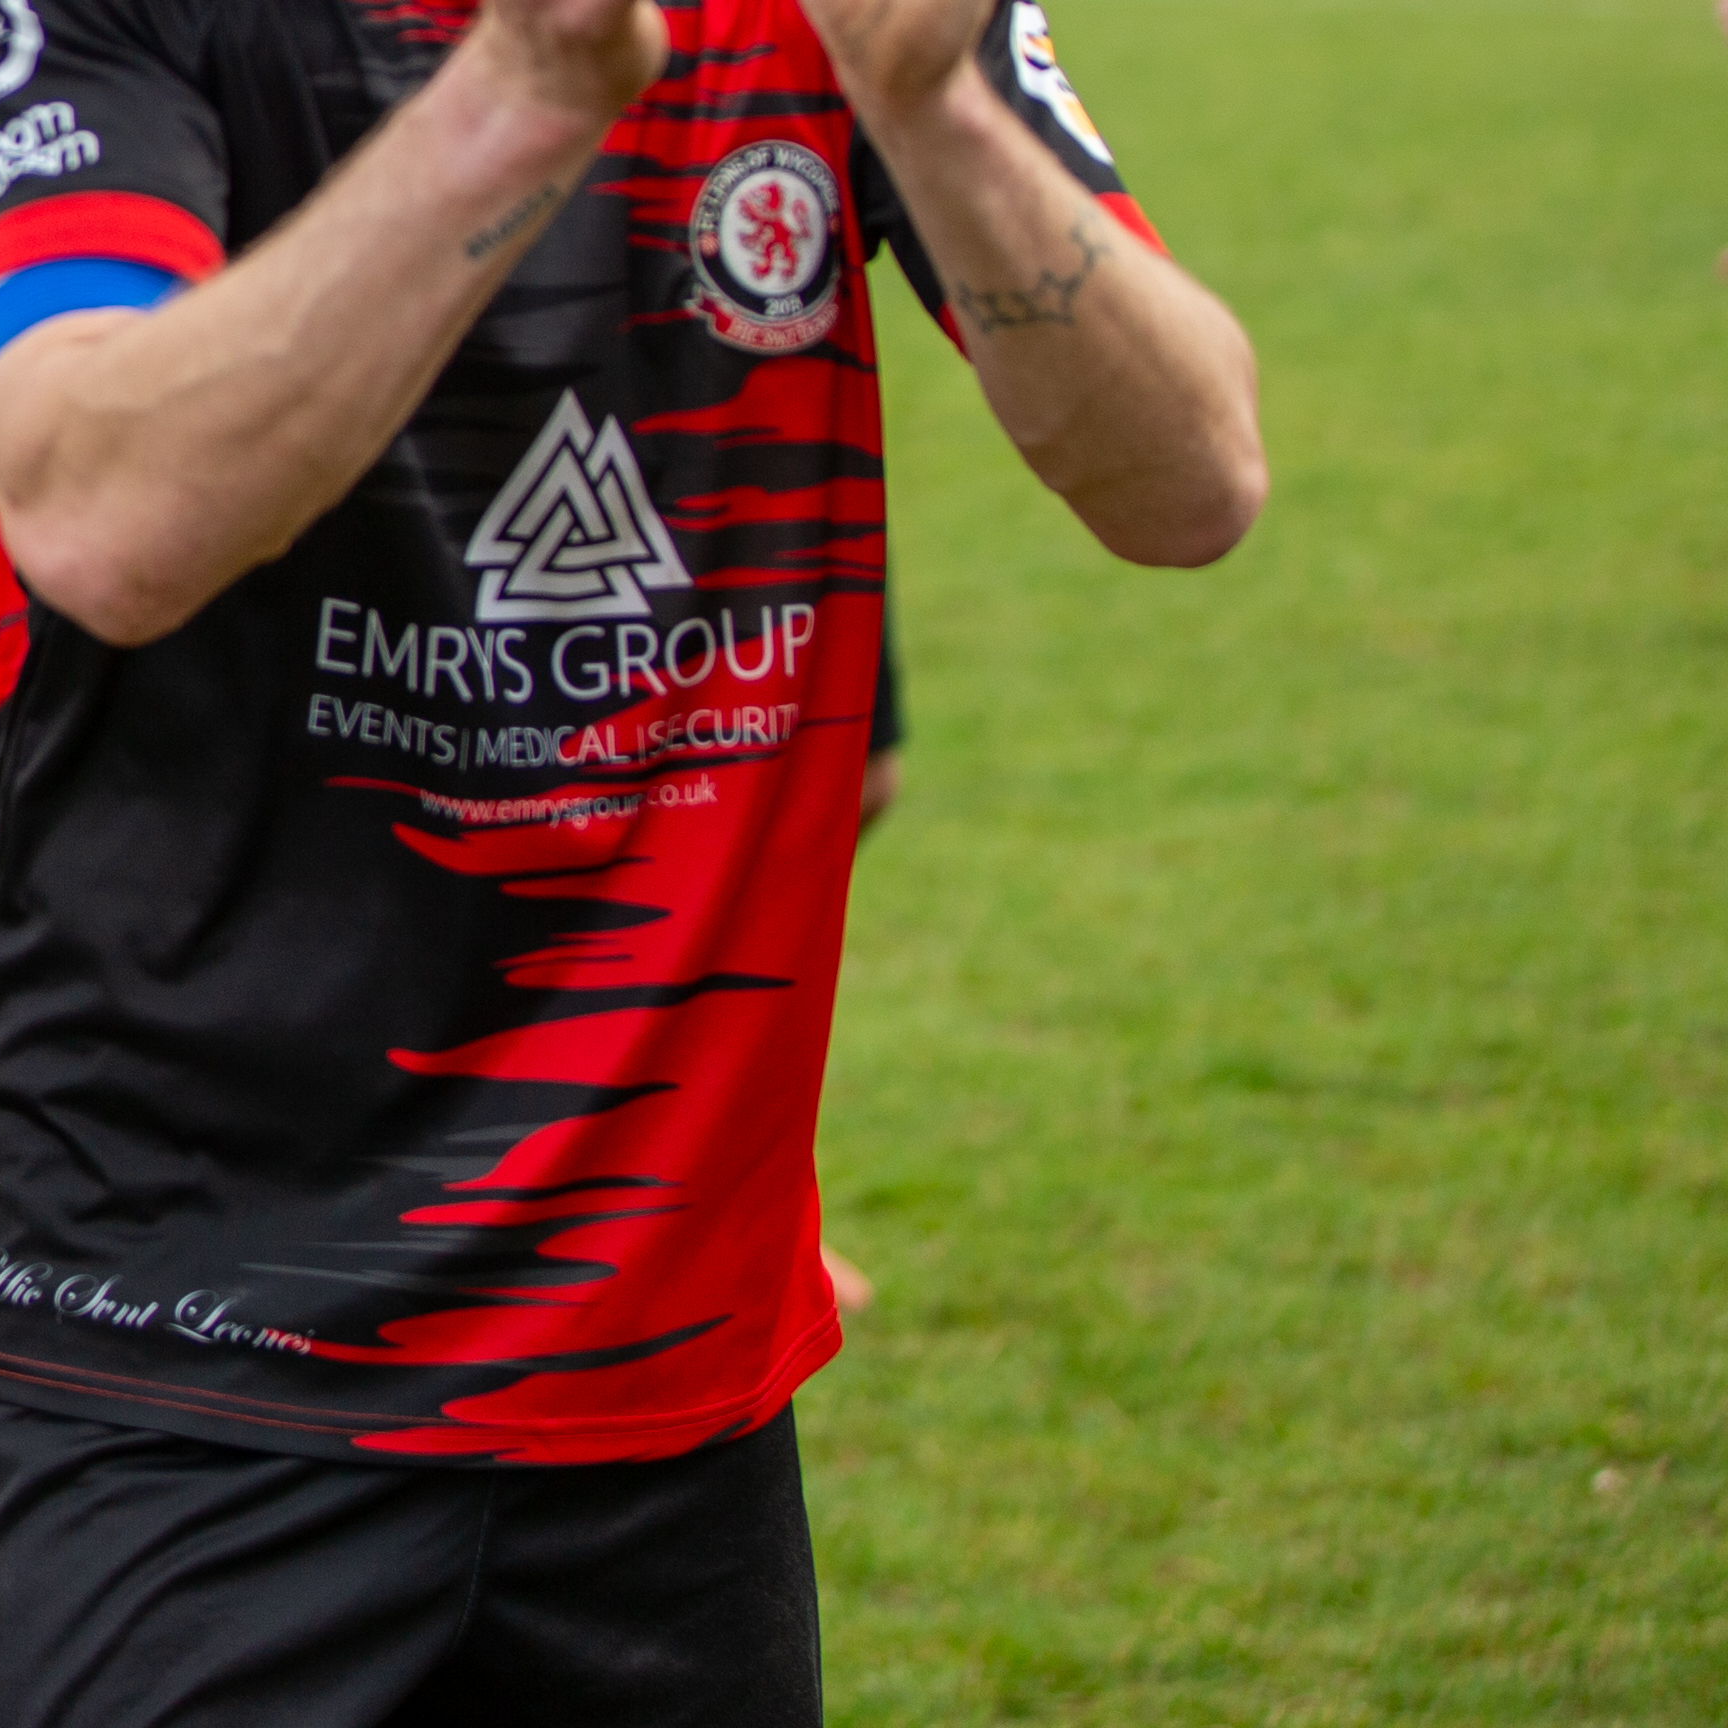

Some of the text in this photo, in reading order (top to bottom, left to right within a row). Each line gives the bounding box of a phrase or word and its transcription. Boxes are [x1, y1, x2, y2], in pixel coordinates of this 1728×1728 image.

[316, 597, 817, 704] EMRYS GROUP
[307, 693, 457, 766] EVENTS
[474, 724, 632, 768] MEDICAL
